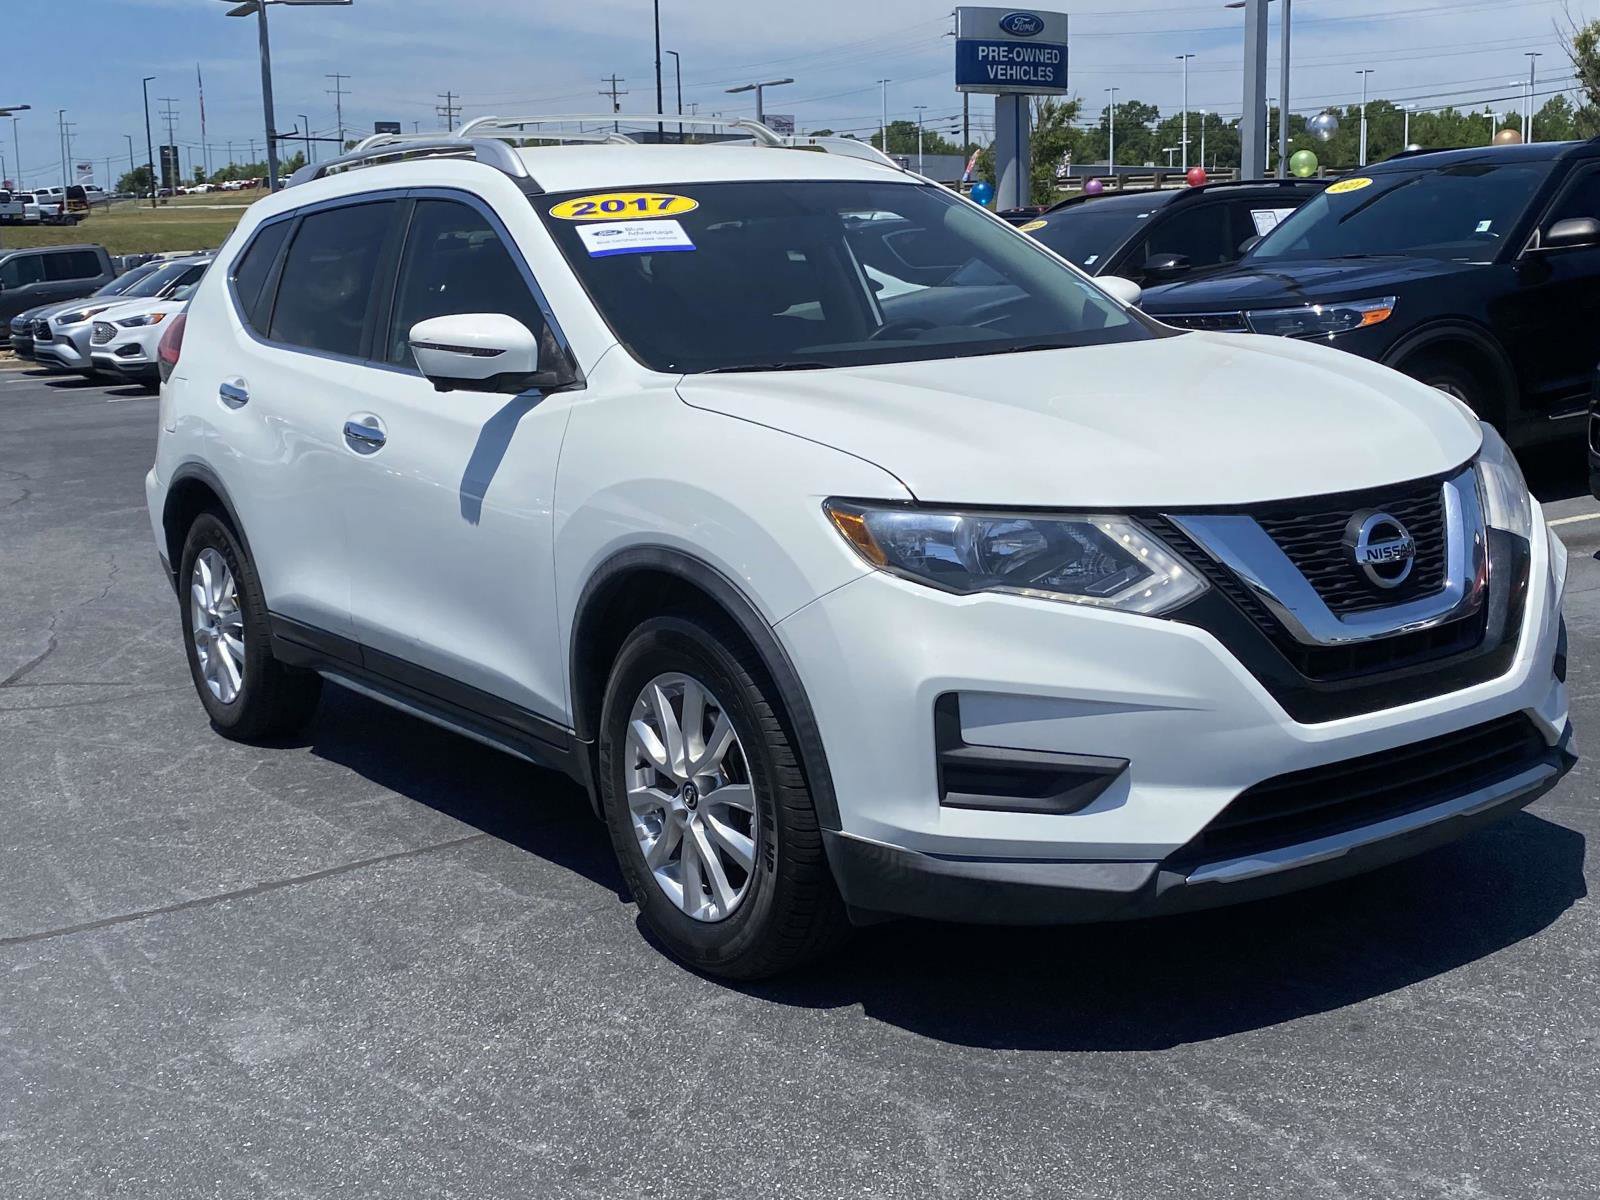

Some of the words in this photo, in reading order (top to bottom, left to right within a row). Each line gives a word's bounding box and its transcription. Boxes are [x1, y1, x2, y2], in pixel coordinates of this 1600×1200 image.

[1011, 17, 1037, 31] Ford
[978, 46, 1060, 64] PRE-OWNED
[987, 65, 1054, 81] VEHICLES
[571, 197, 678, 217] 2017
[1366, 541, 1414, 560] NISSAN
